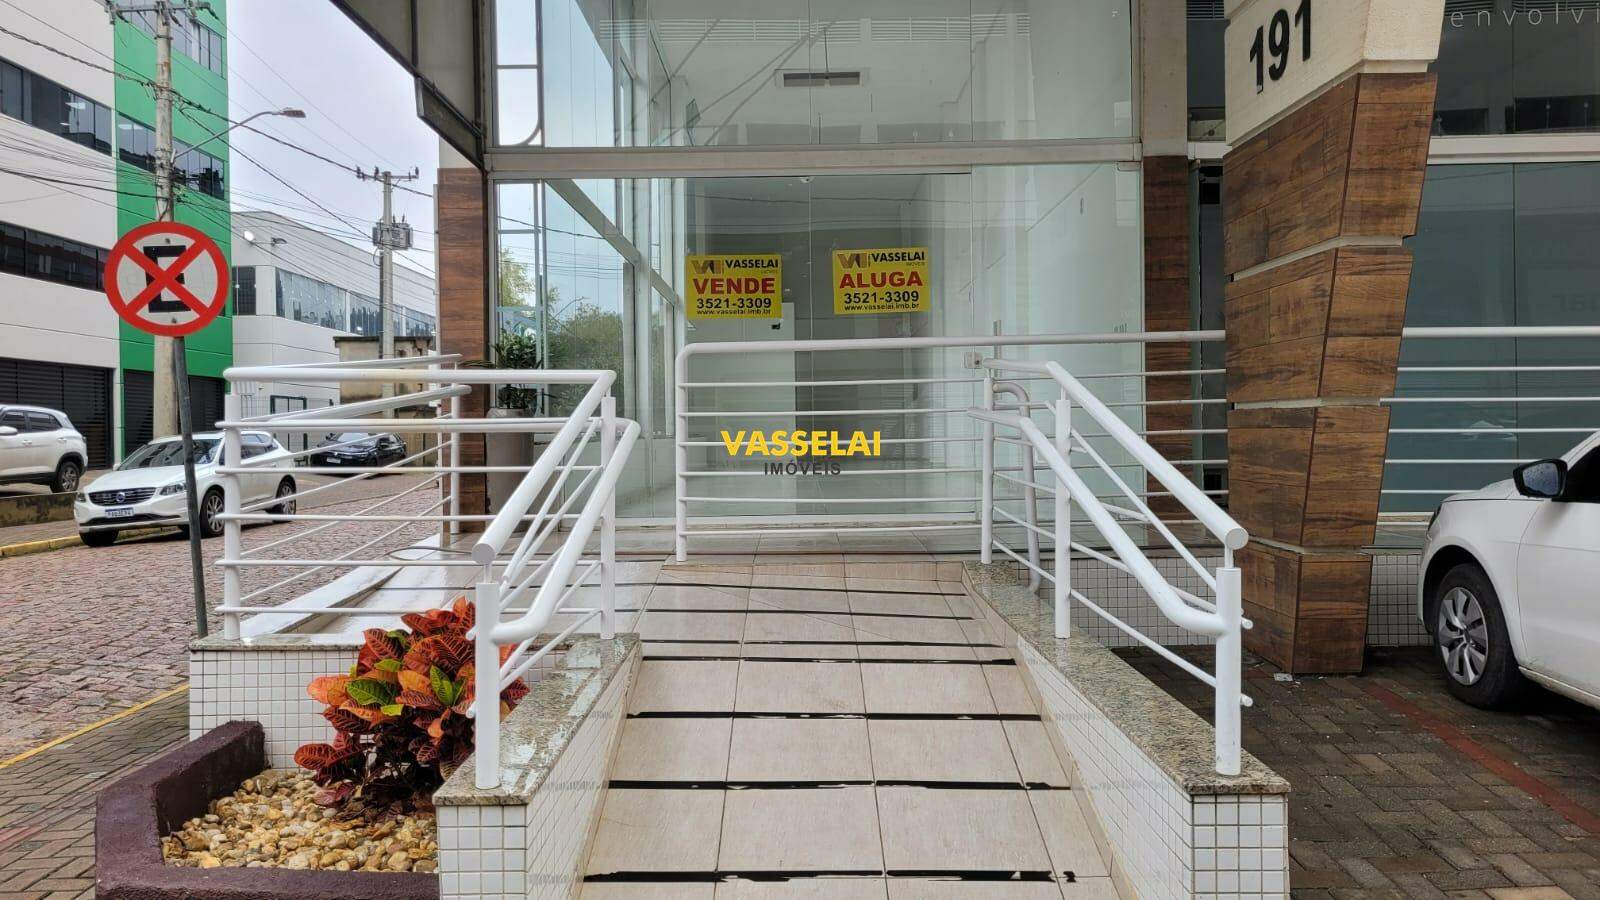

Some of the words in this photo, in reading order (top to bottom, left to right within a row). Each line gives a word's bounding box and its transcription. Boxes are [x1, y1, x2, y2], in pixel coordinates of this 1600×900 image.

[1249, 0, 1311, 95] 191
[871, 251, 925, 262] VASSELAI
[725, 259, 779, 268] VASSELAI
[840, 271, 923, 289] ALUGA
[692, 278, 776, 295] VENDE
[697, 298, 772, 309] 3521-3309
[844, 291, 919, 304] 3521-3309
[844, 302, 919, 311] www.vasselai.imb.br
